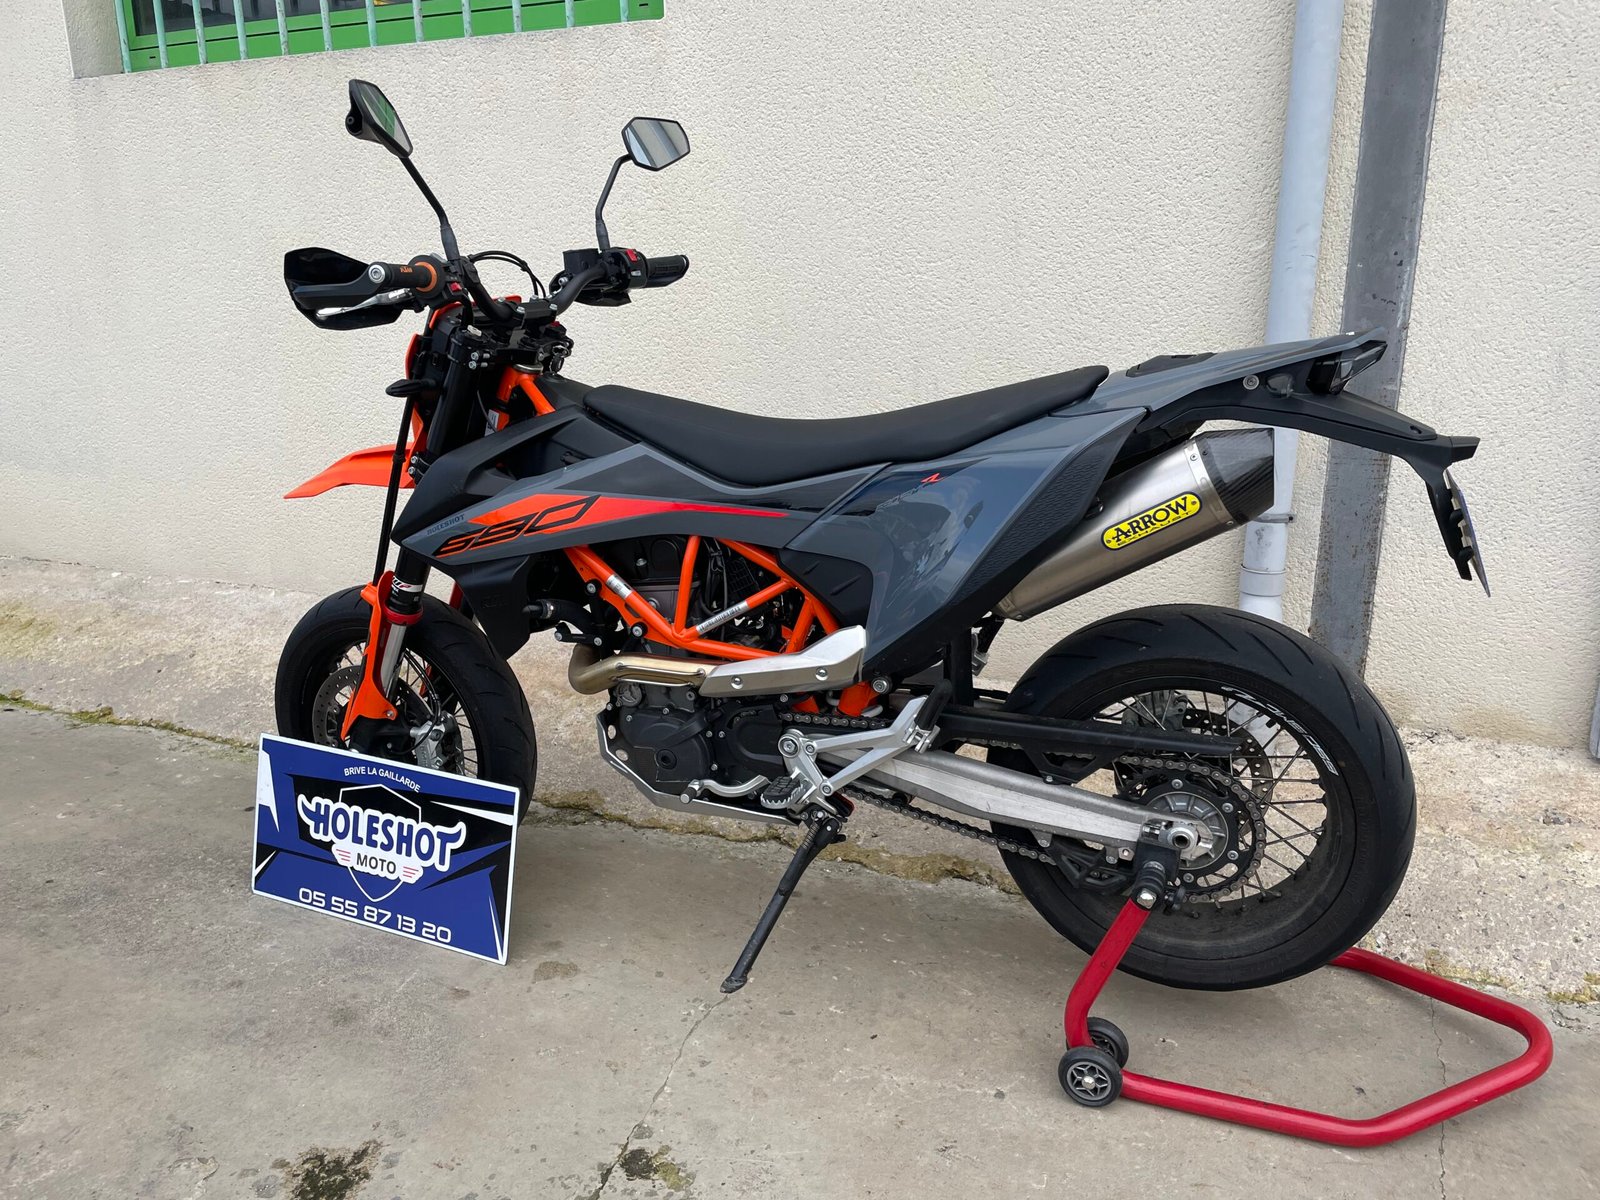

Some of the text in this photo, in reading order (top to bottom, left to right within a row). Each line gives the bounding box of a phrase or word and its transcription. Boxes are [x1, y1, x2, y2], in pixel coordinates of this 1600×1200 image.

[426, 514, 465, 536] HOLESHOT
[1111, 496, 1188, 543] ARROW
[343, 766, 421, 793] BRIVE LA GAILLARDE
[299, 798, 464, 868] HOLESHOT
[356, 852, 397, 875] MOTO
[299, 887, 452, 943] 05 55 87 13 20
